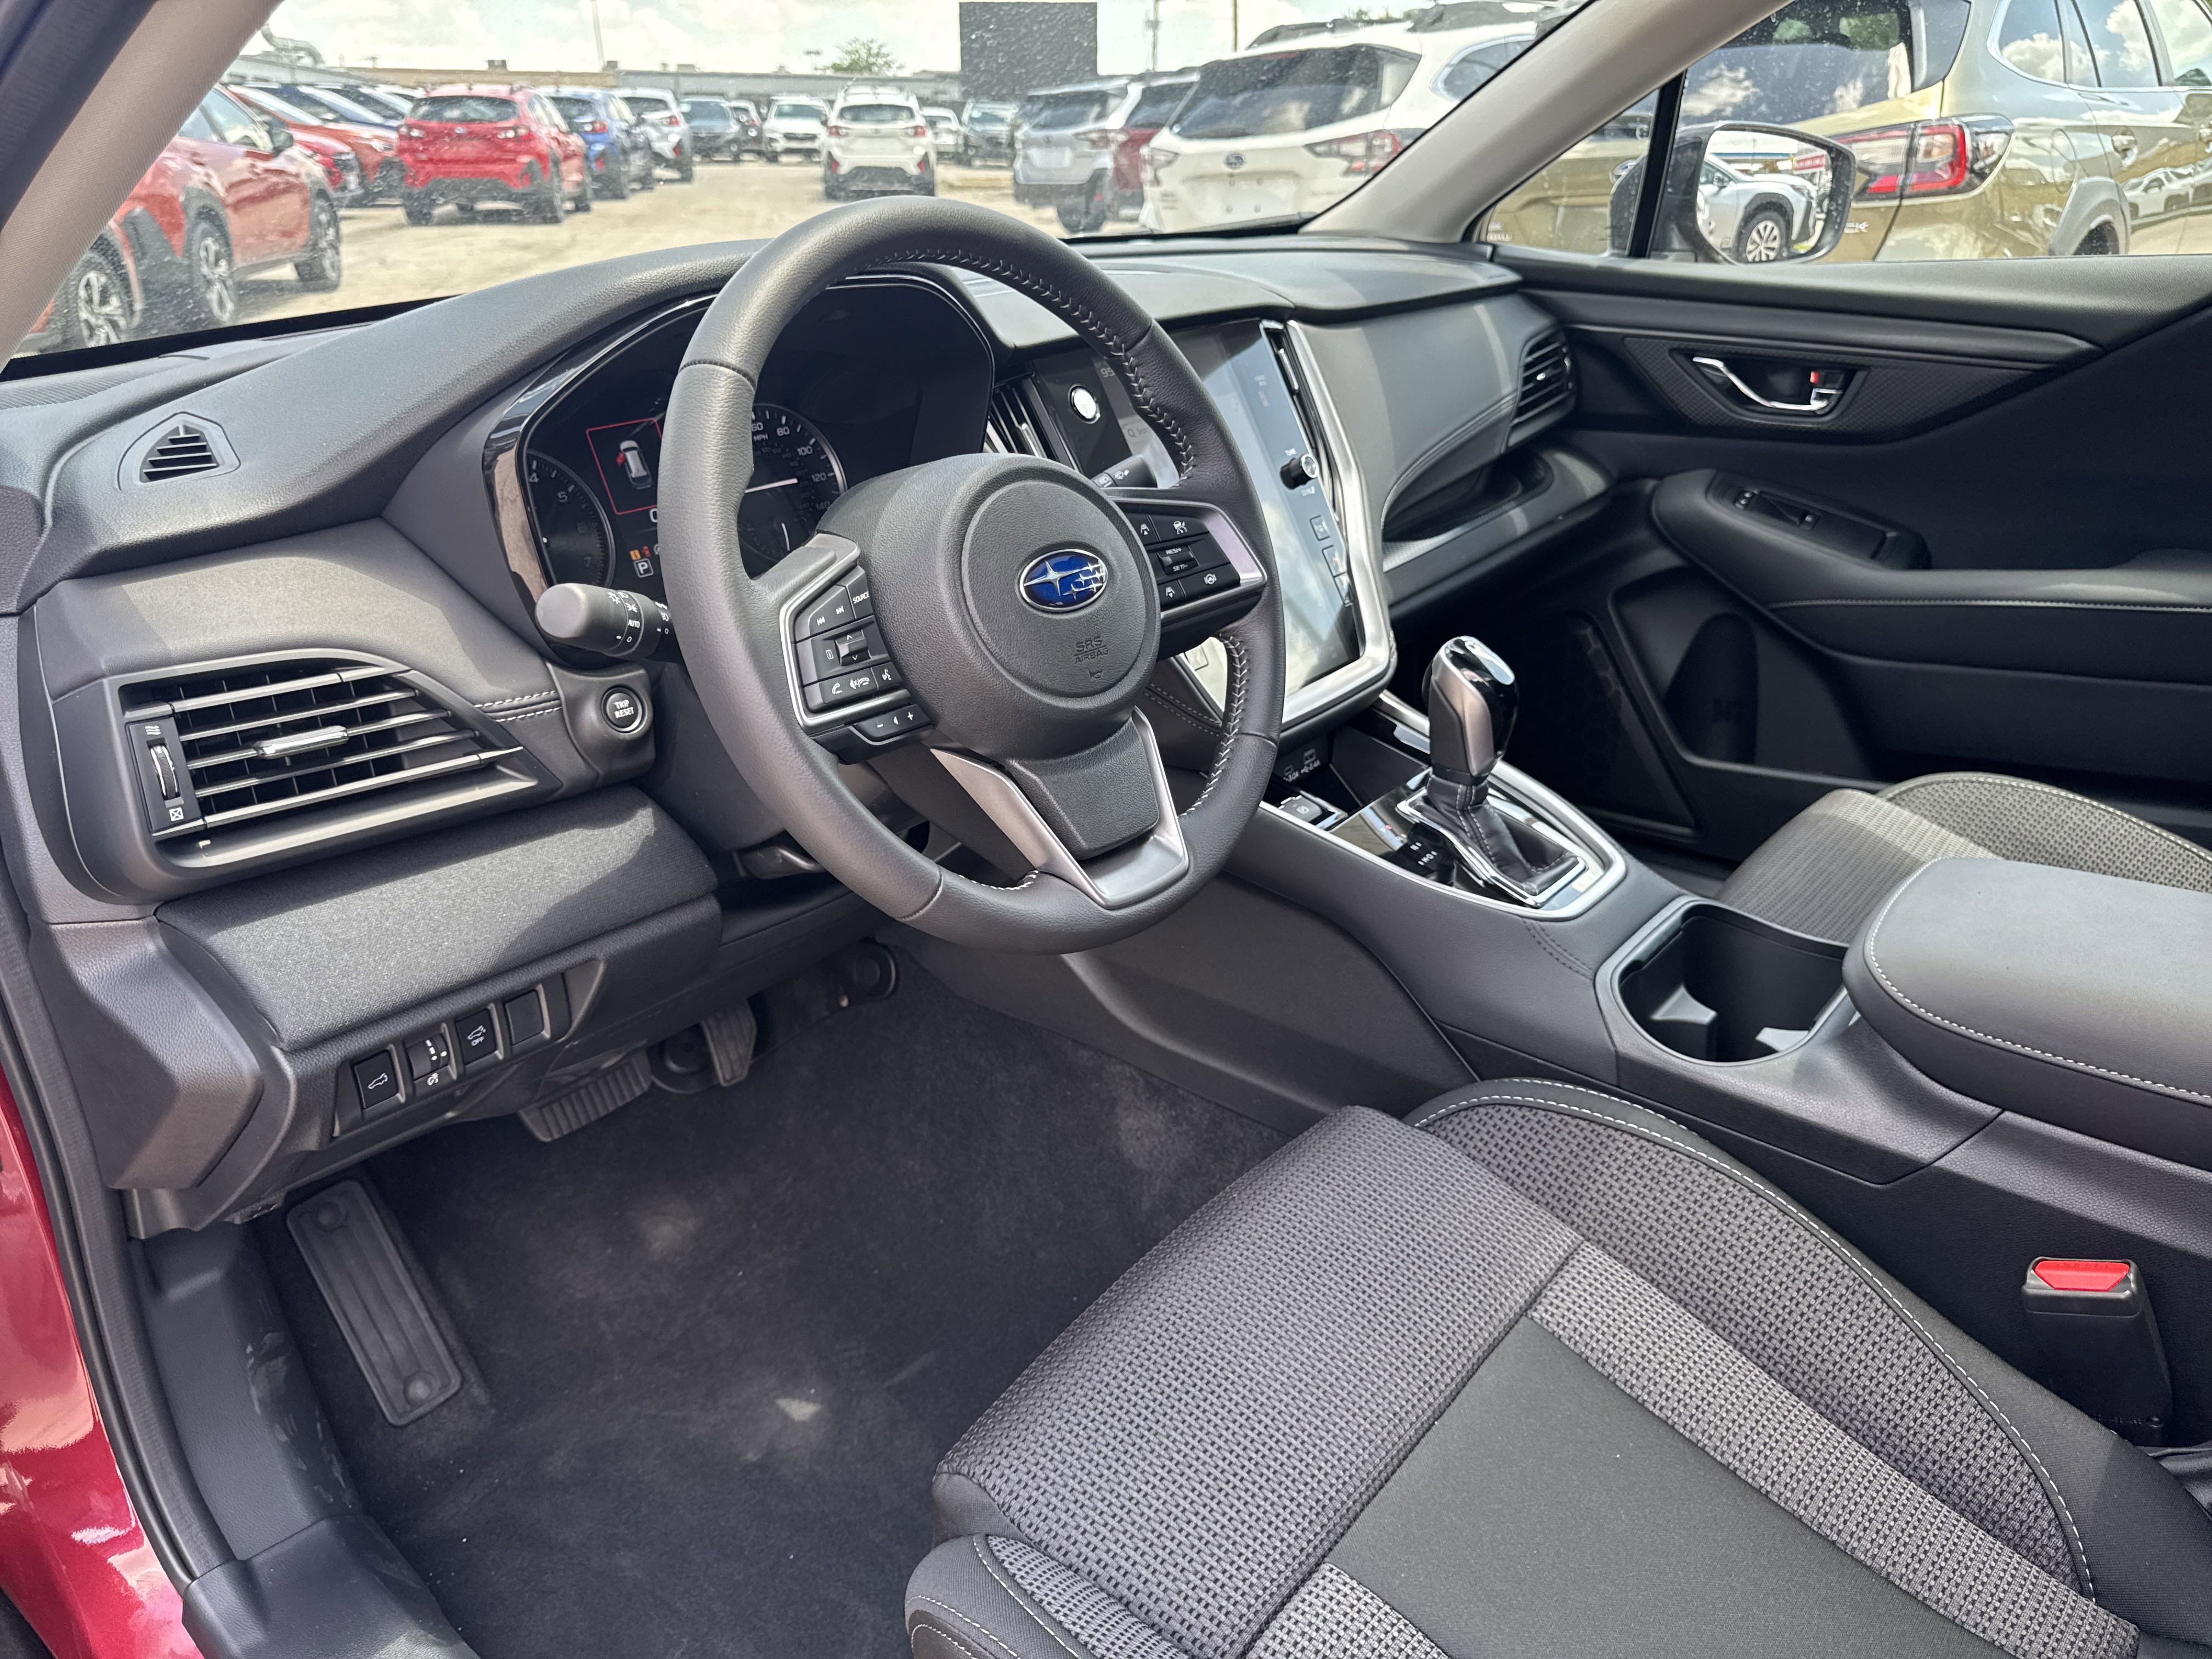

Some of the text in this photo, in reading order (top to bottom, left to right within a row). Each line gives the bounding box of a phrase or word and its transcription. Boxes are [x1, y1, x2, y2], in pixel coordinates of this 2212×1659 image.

[752, 422, 763, 432] 60
[776, 426, 790, 436] 80
[753, 434, 769, 442] MPH
[797, 445, 812, 456] 100
[529, 472, 539, 483] 4
[811, 472, 827, 482] 120
[557, 491, 568, 503] 5
[637, 562, 648, 574] P
[853, 591, 870, 604] SOURCE
[628, 619, 640, 628] AUTO
[1076, 636, 1102, 652] SRS
[1075, 647, 1109, 664] AIRBAG
[614, 699, 630, 709] TRIP
[614, 707, 634, 719] RESET
[471, 1036, 485, 1046] OFF
